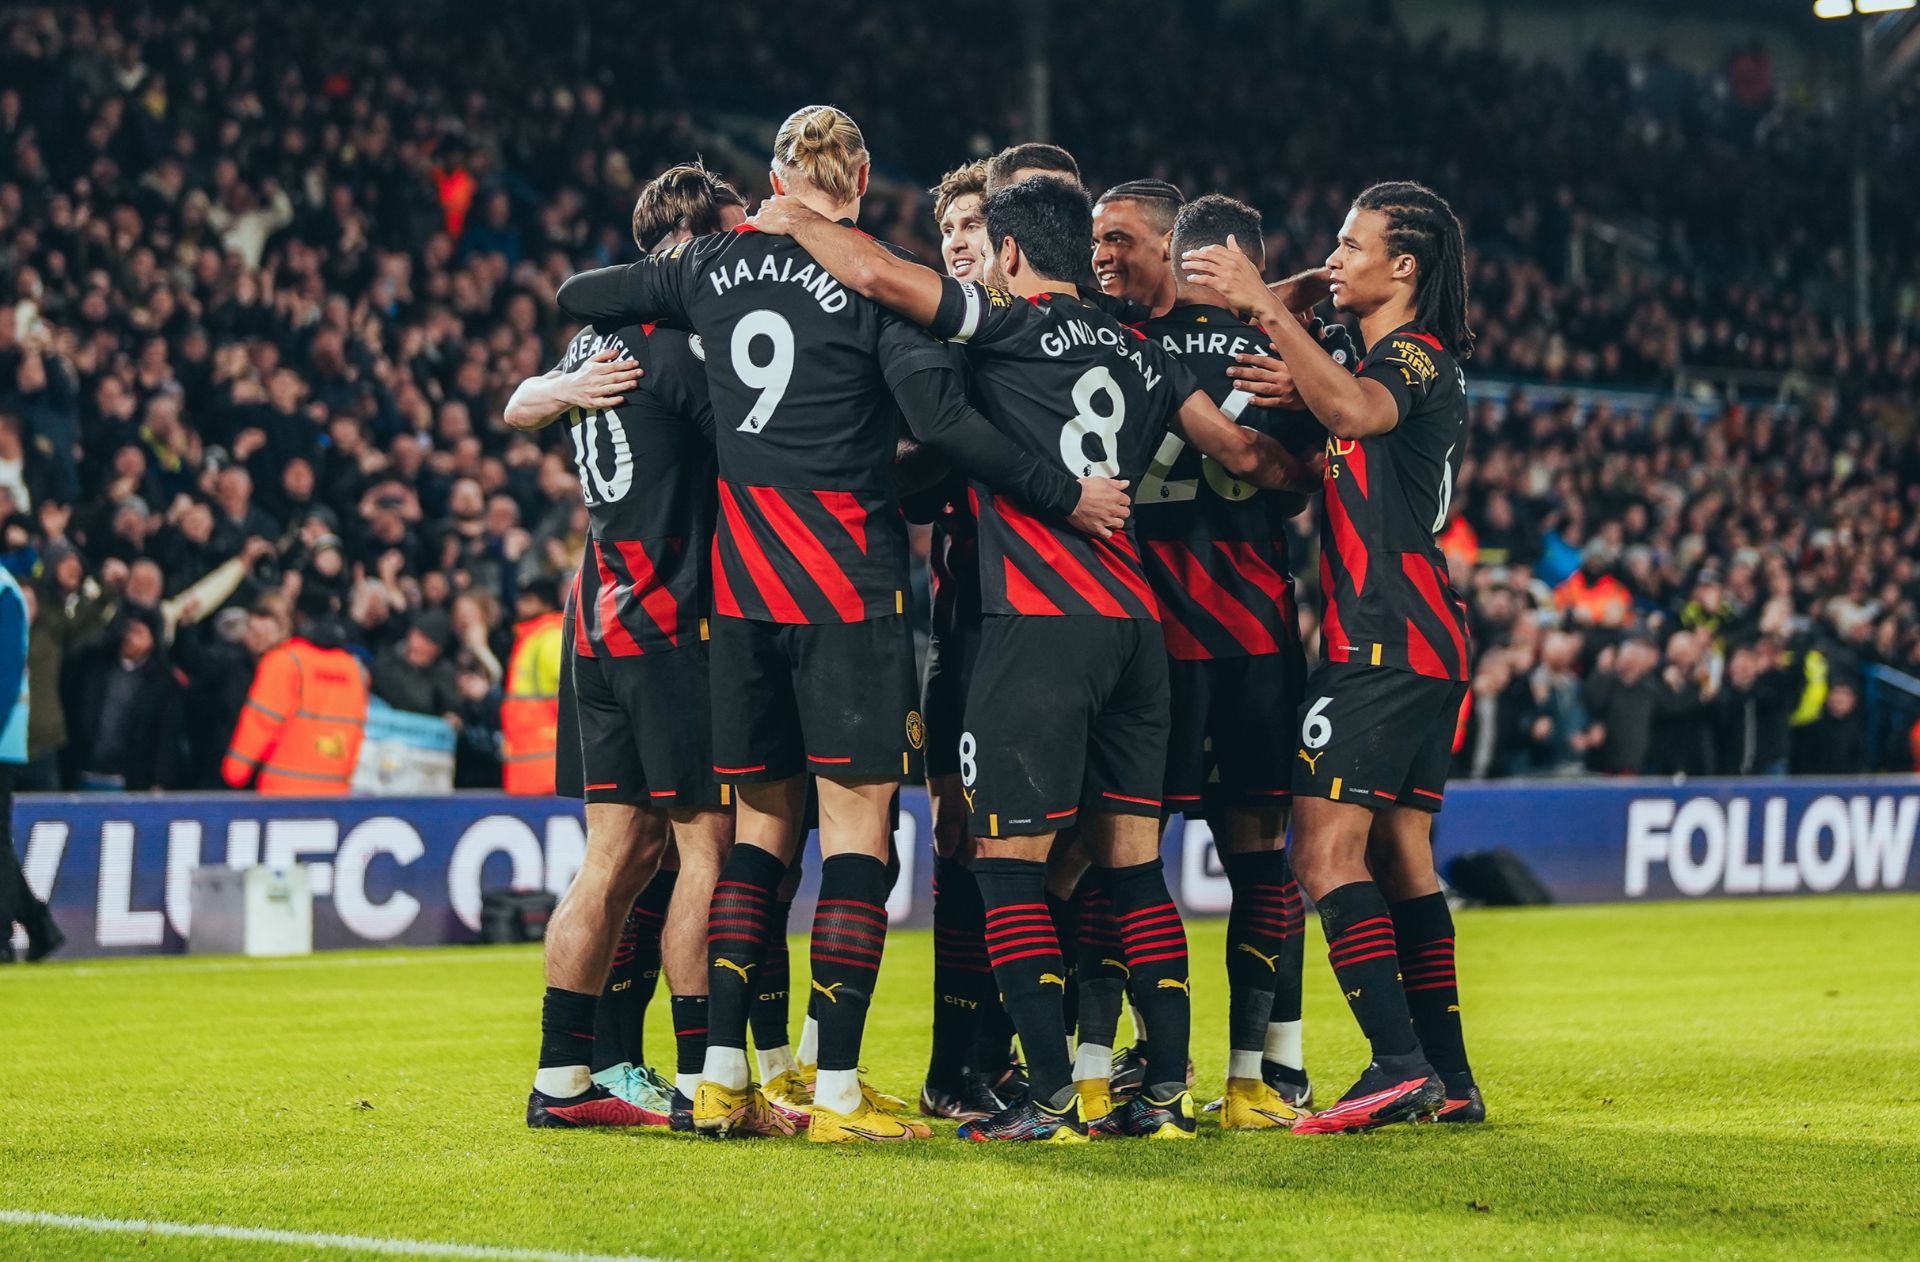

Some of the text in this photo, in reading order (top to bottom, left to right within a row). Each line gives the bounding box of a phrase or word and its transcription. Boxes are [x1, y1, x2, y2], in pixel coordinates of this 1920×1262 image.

[1162, 333, 1269, 359] AHRE
[1391, 340, 1439, 380] NEXEN
[1399, 349, 1431, 381] TIRE
[731, 309, 795, 434] 9
[1060, 366, 1126, 478] 8
[569, 406, 634, 507] 10
[1302, 696, 1335, 749] 6
[959, 731, 977, 787] 8
[1625, 796, 1920, 896] FOLLOW
[612, 979, 631, 991] CIT
[759, 991, 788, 1000] CIT
[944, 995, 977, 1009] CITY
